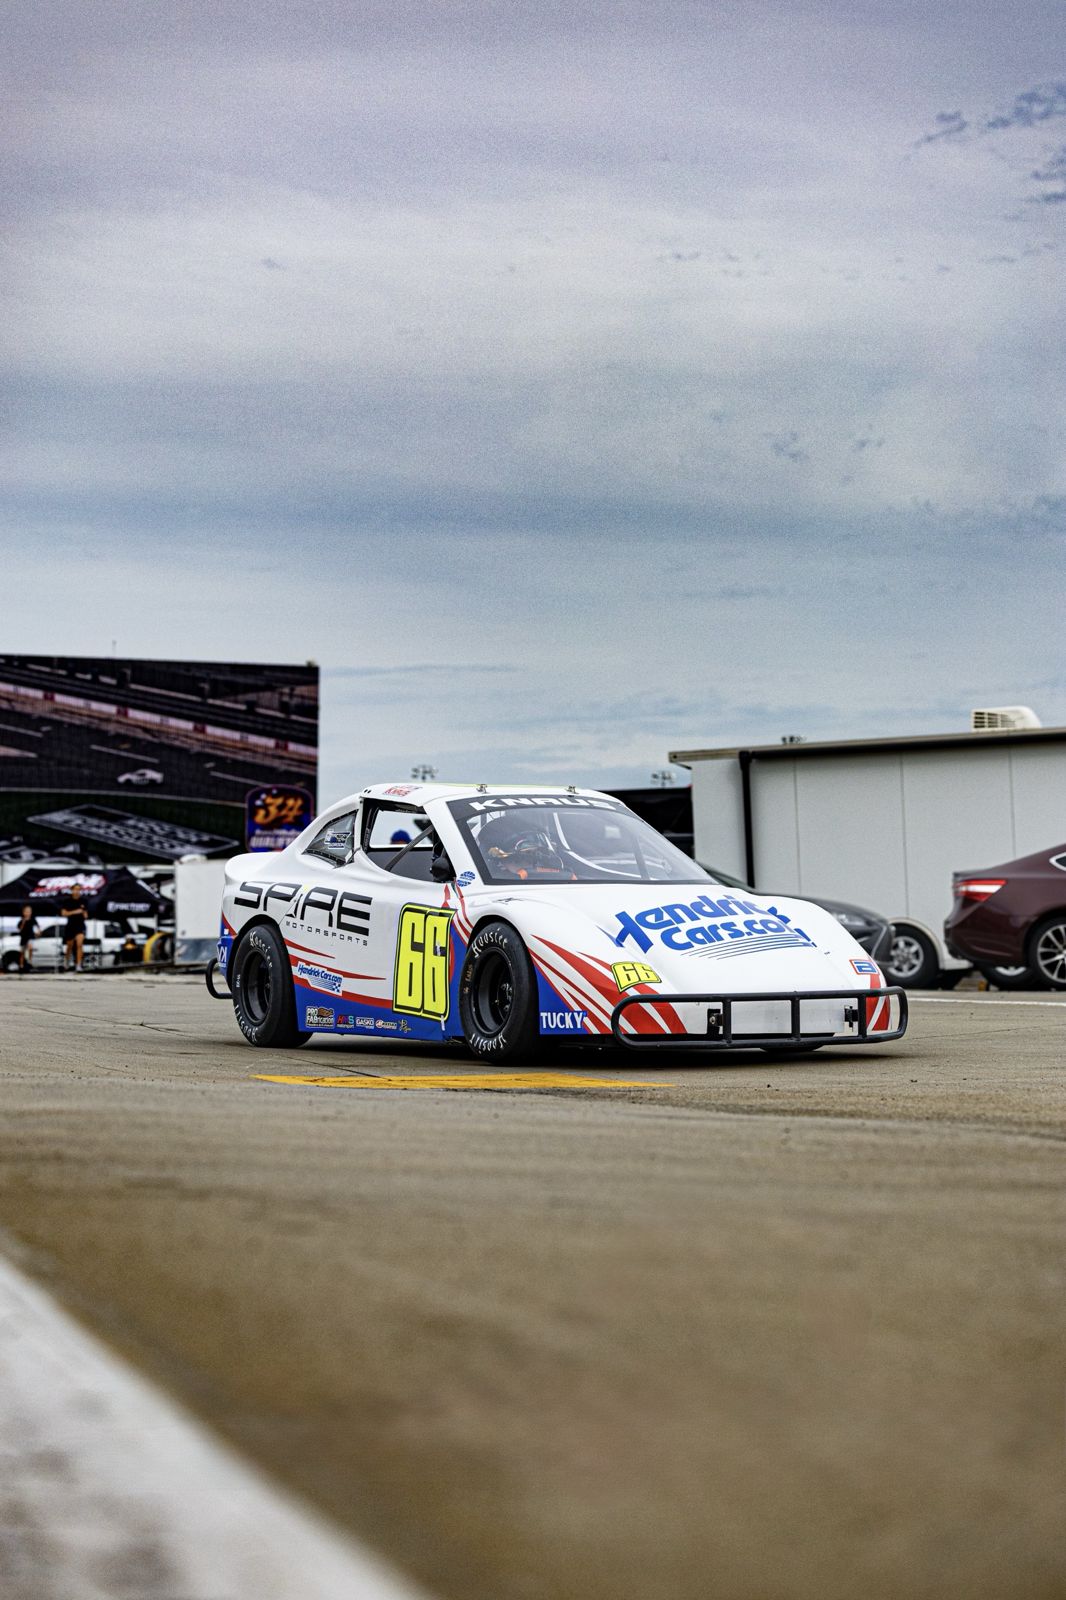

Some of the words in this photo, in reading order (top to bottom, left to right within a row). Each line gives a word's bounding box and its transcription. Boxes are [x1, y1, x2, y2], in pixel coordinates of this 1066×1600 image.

[470, 797, 617, 811] KNAUS
[285, 920, 368, 947] MOTORSPORTS
[472, 928, 508, 959] Hoosier
[394, 905, 454, 1018] 66
[612, 961, 661, 991] 66
[540, 1012, 583, 1029] TUCKY
